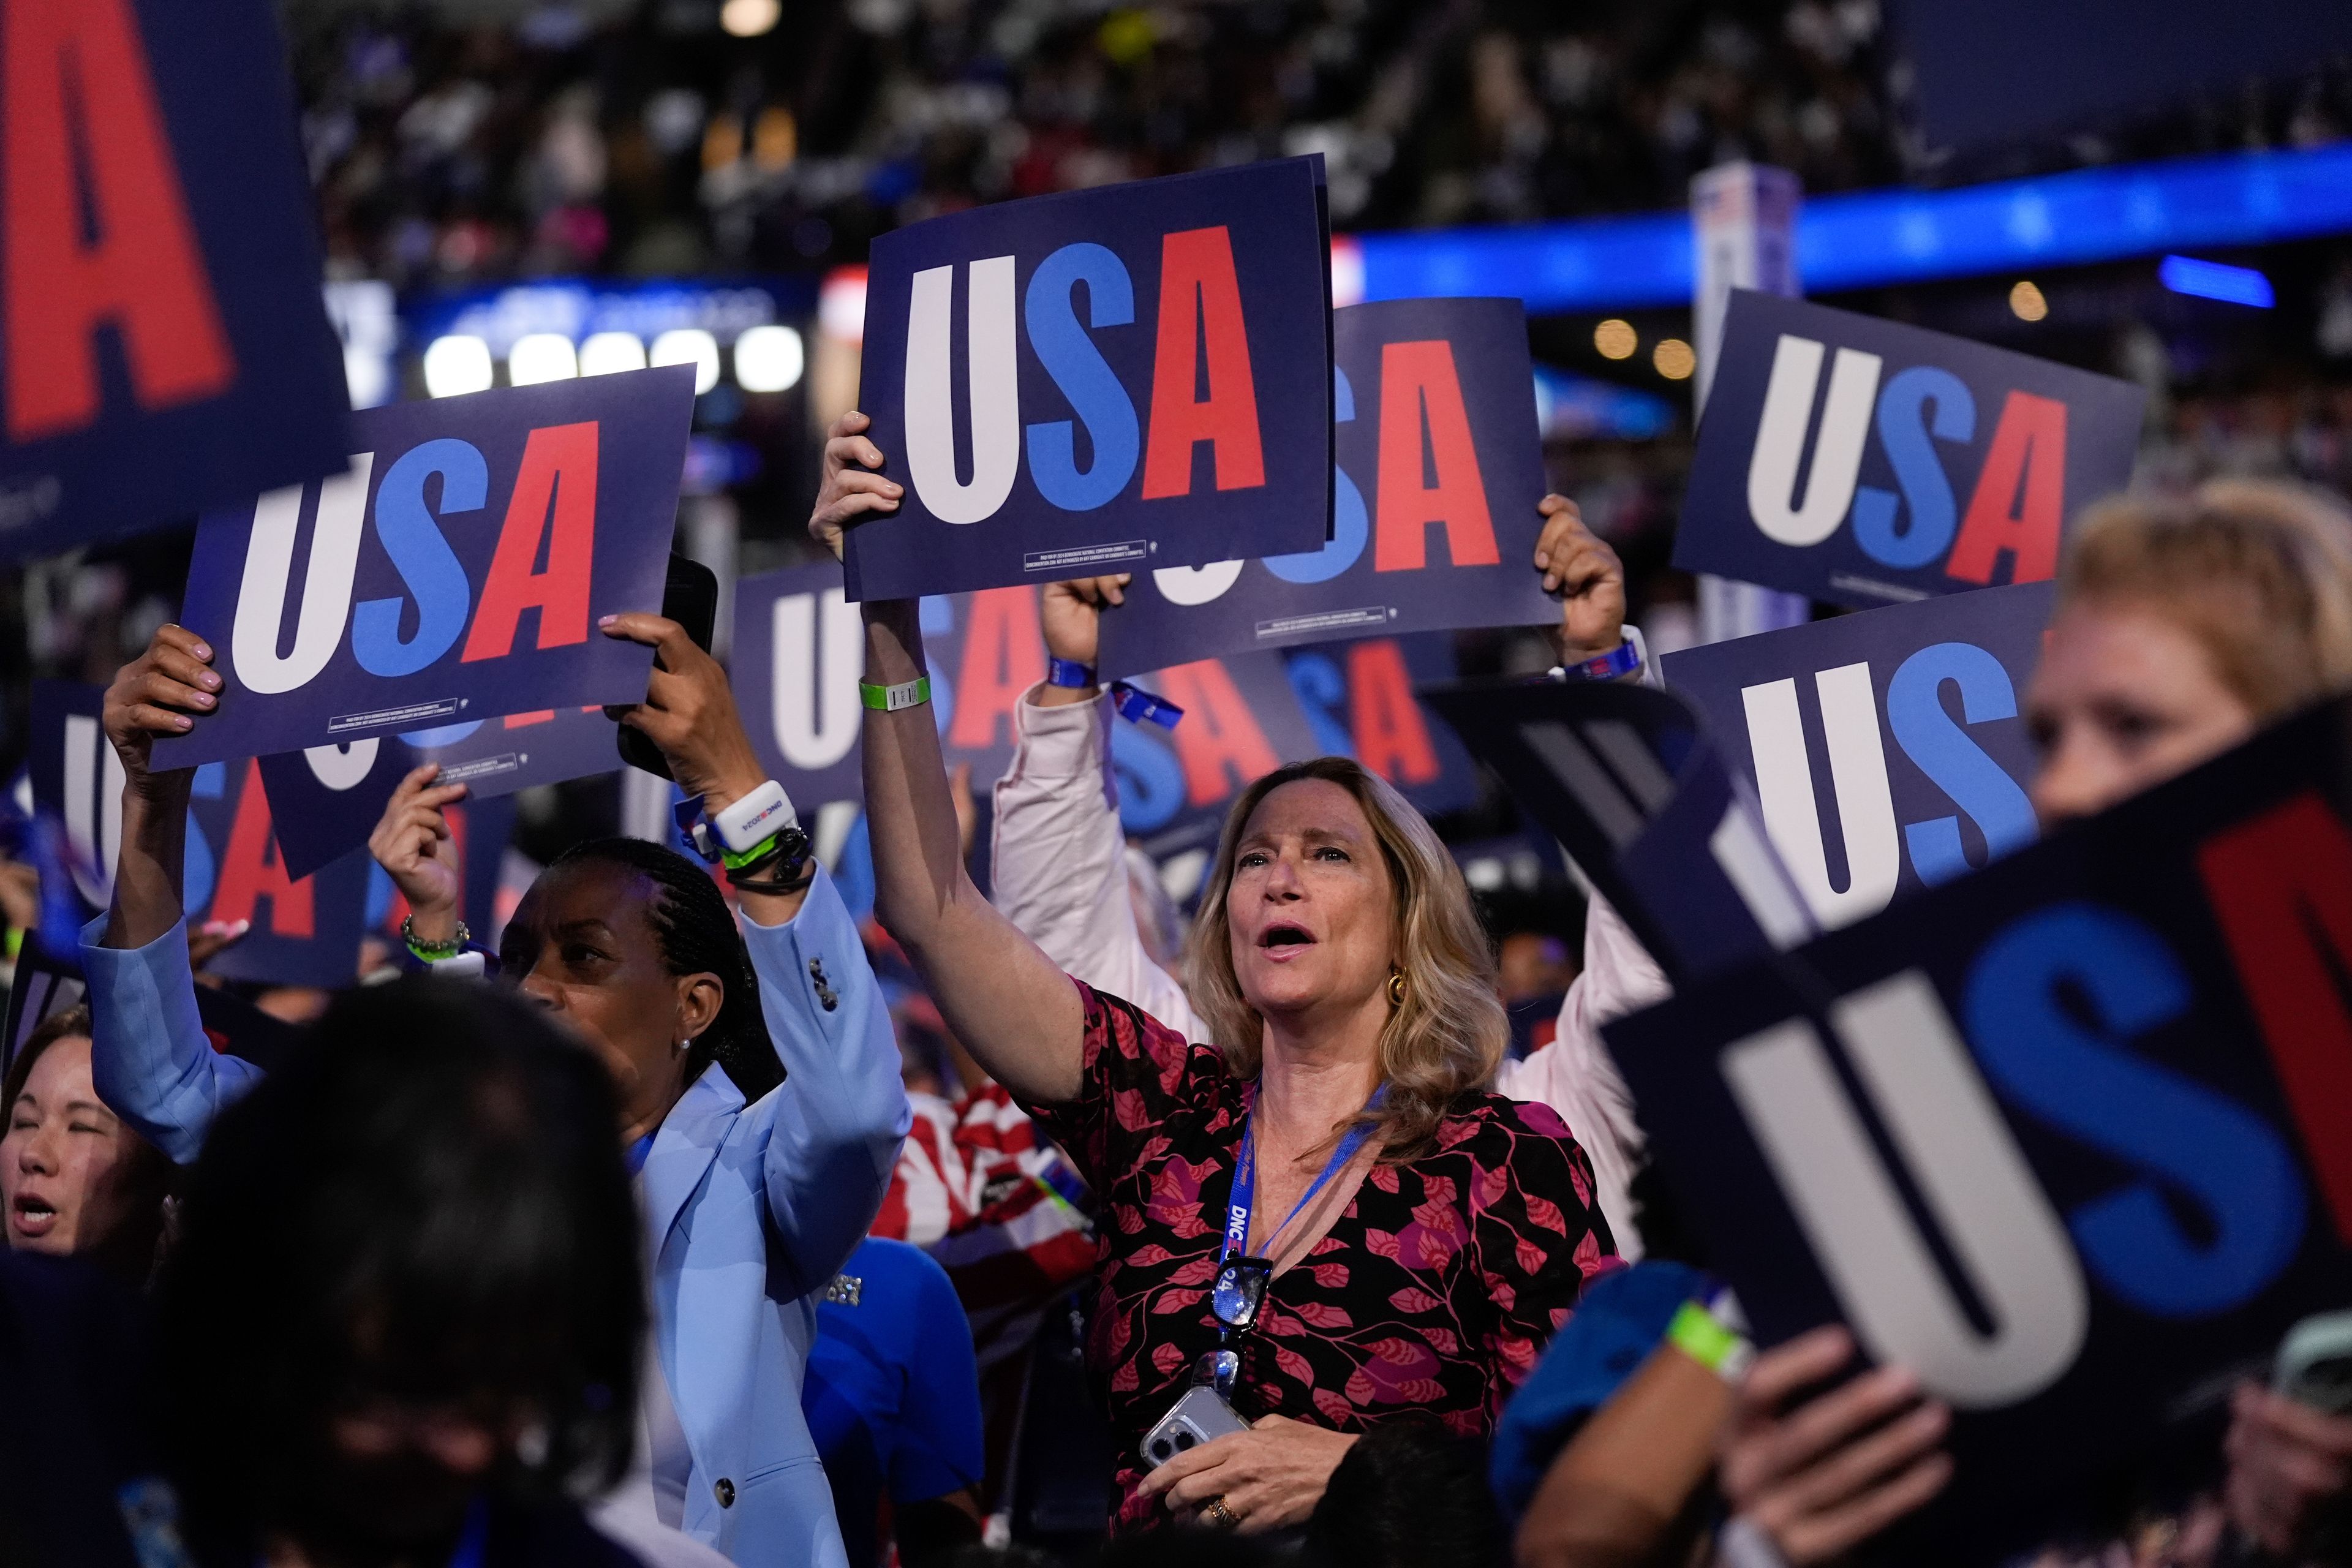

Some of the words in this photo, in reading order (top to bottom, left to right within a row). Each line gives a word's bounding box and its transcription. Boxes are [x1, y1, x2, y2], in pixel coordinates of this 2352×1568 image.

[905, 225, 1265, 524] USA
[1747, 334, 2067, 585] USA
[232, 421, 598, 694] USA
[1741, 631, 2054, 933] US
[1229, 1205, 1247, 1242] DNC
